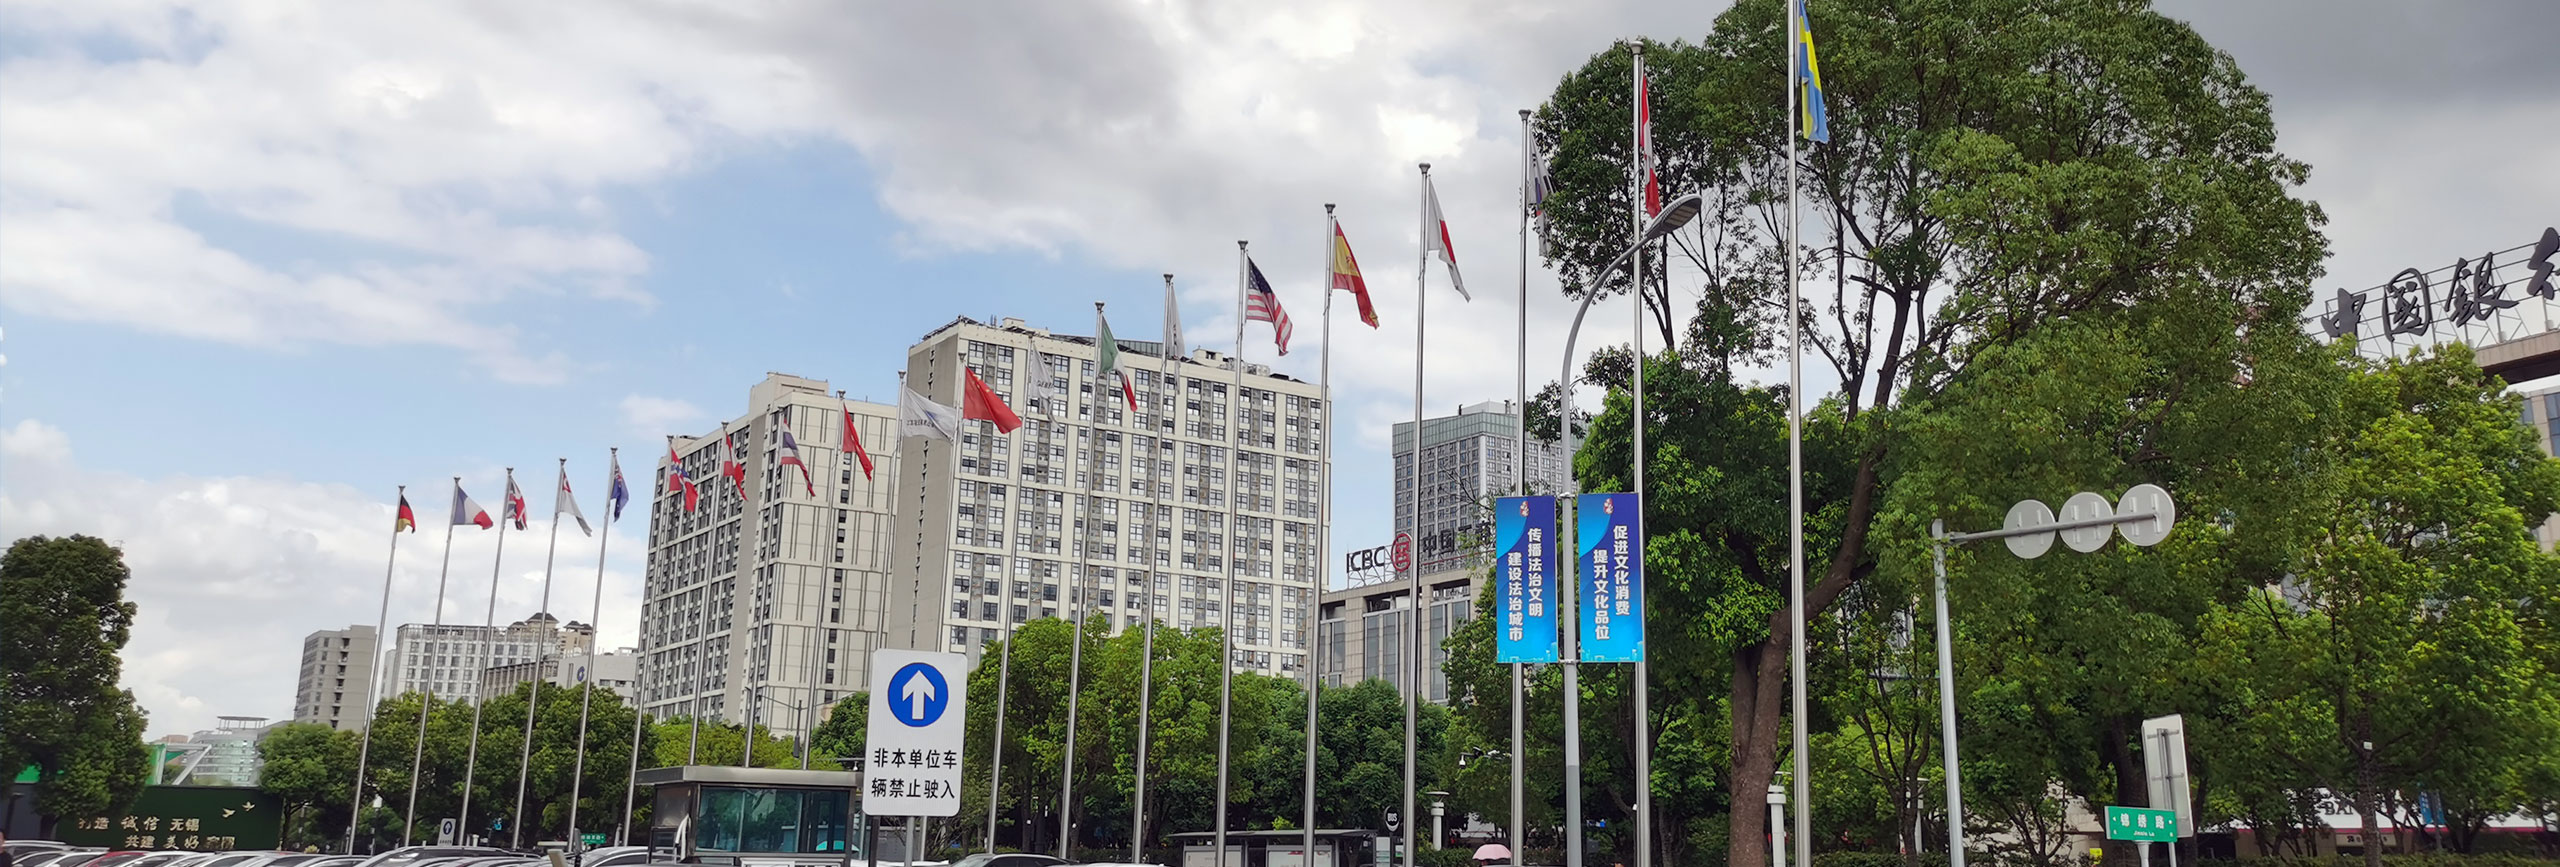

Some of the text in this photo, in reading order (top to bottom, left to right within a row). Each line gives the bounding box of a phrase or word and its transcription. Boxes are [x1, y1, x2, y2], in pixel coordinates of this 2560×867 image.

[1346, 546, 1386, 573] ICBC
[1527, 528, 1543, 617] 传播法治文明
[1613, 525, 1631, 616] 促进文化消费
[1507, 552, 1524, 641] 建设法治城市
[1593, 549, 1610, 640] 提升文化品位
[874, 747, 957, 769] 非本单位车
[871, 777, 955, 799] 辆禁止驶入
[170, 818, 200, 831] 无锡
[1387, 813, 1397, 821] BUS
